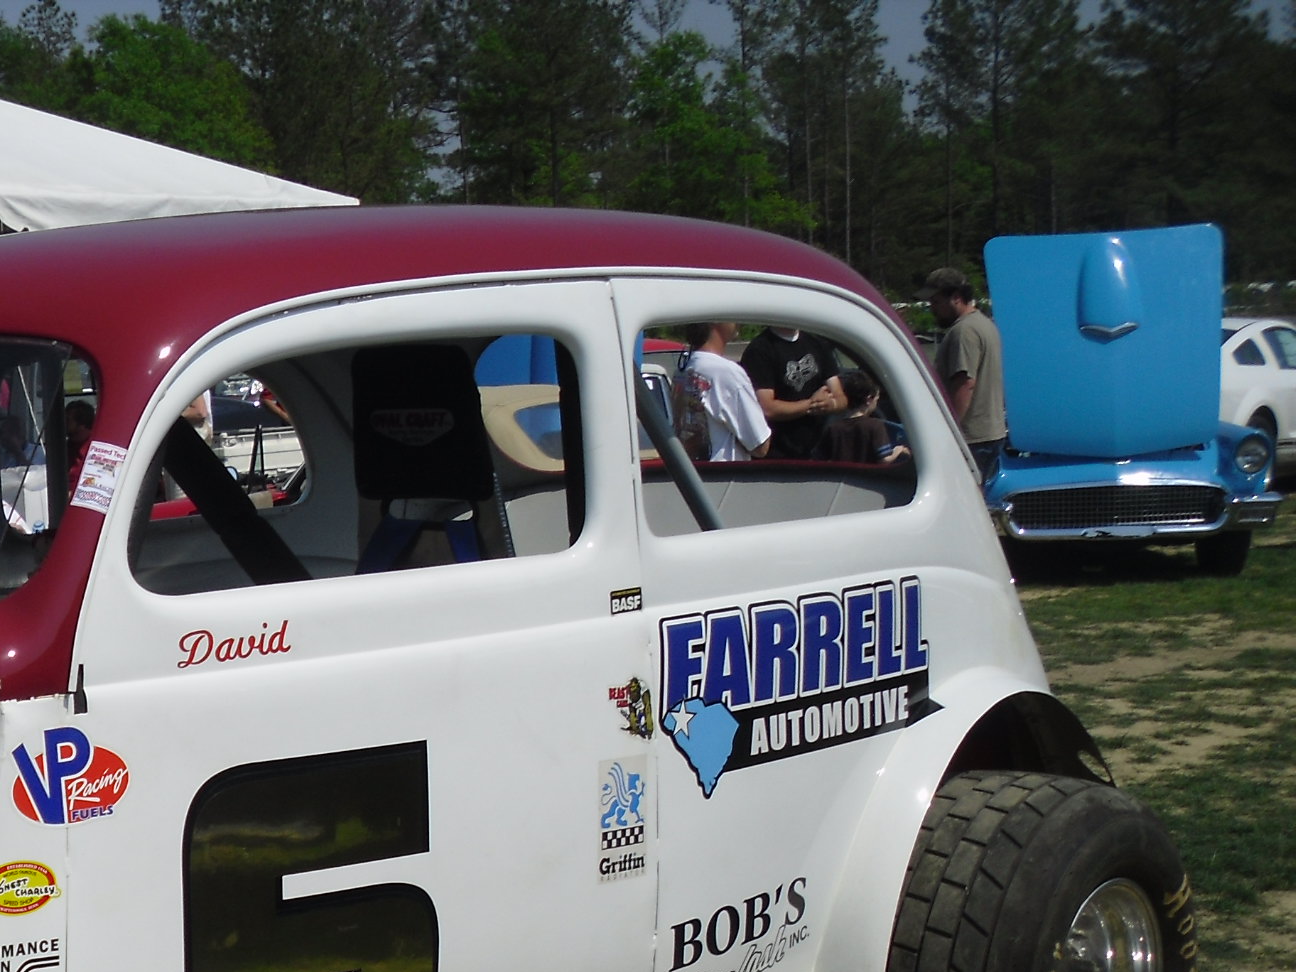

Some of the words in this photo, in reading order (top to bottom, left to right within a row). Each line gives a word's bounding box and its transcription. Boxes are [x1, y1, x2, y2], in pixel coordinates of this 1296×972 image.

[611, 595, 641, 613] BASF
[176, 619, 291, 669] David
[661, 576, 929, 716] FARRELL
[750, 686, 910, 756] AUTOMOTIVE
[11, 726, 91, 825] VP
[67, 767, 128, 811] Racing
[71, 805, 114, 821] FUELS
[599, 853, 645, 876] Griffin
[15, 886, 55, 897] CHARLEY
[668, 876, 807, 972] BOB'S
[789, 925, 810, 948] INC.
